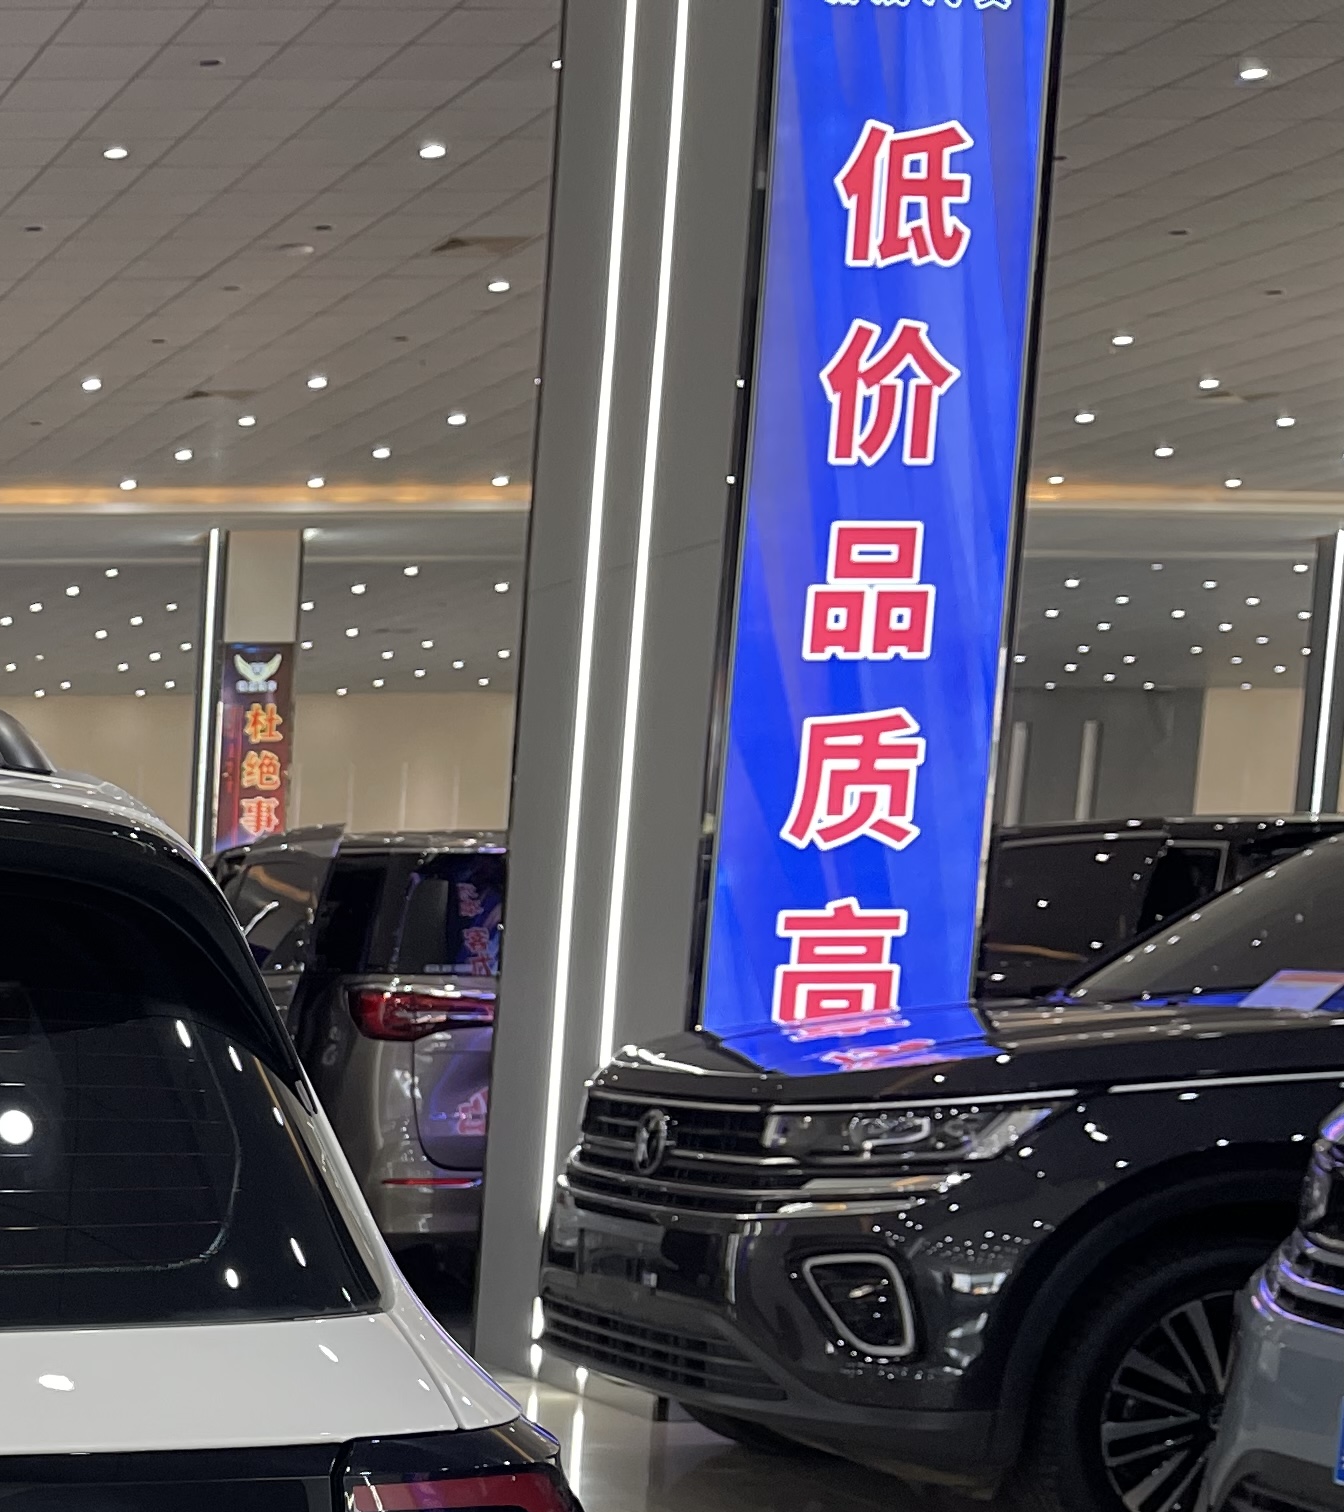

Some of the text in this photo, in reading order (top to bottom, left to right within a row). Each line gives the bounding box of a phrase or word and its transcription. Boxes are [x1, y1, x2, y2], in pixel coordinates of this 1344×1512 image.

[773, 119, 973, 1022] 低价品质高
